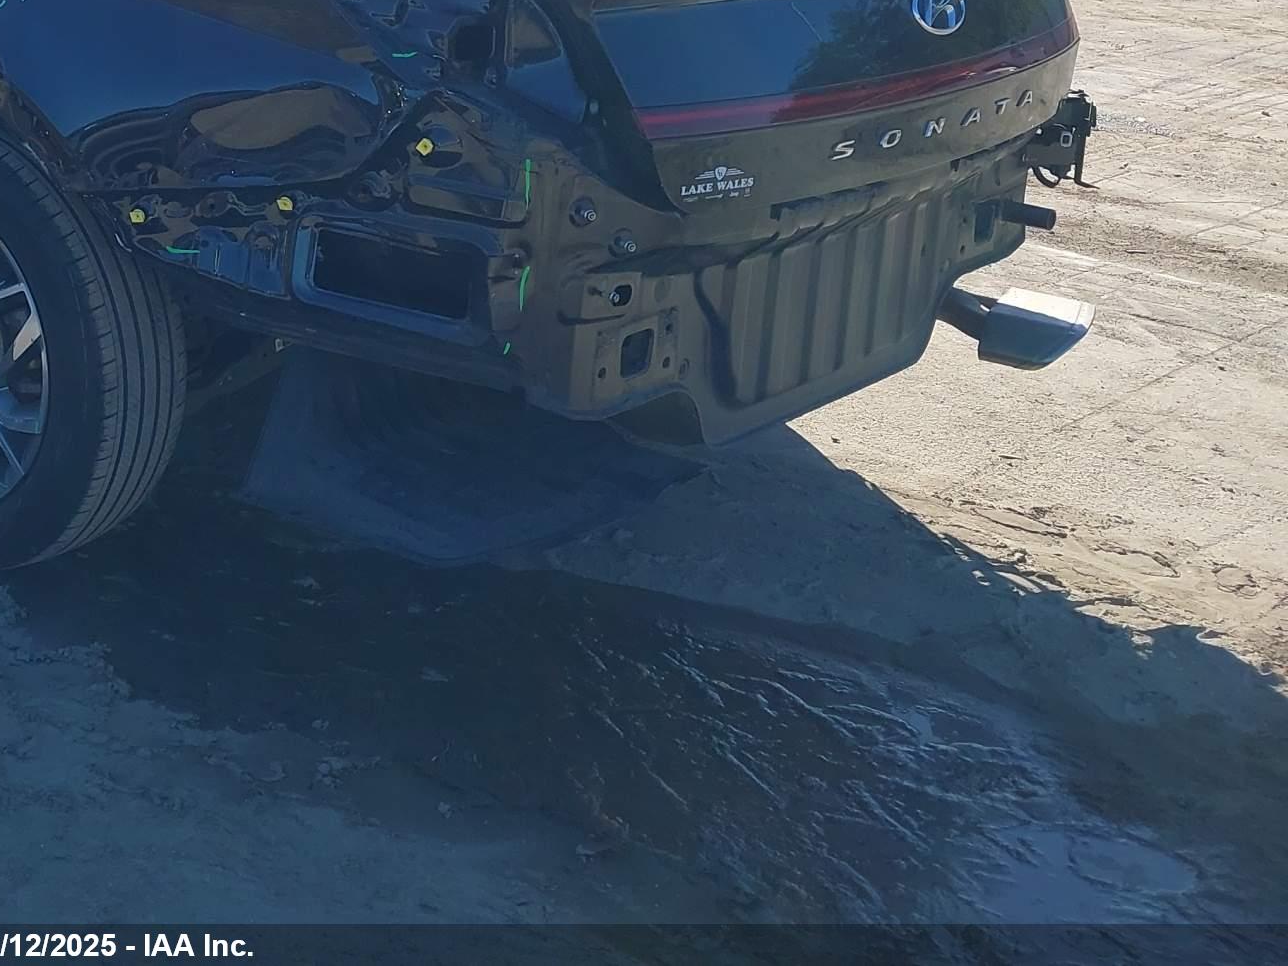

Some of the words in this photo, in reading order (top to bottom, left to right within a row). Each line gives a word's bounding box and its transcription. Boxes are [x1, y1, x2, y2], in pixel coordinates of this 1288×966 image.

[830, 89, 1033, 161] SONATA
[680, 182, 714, 196] LAKE
[716, 177, 754, 191] WALES
